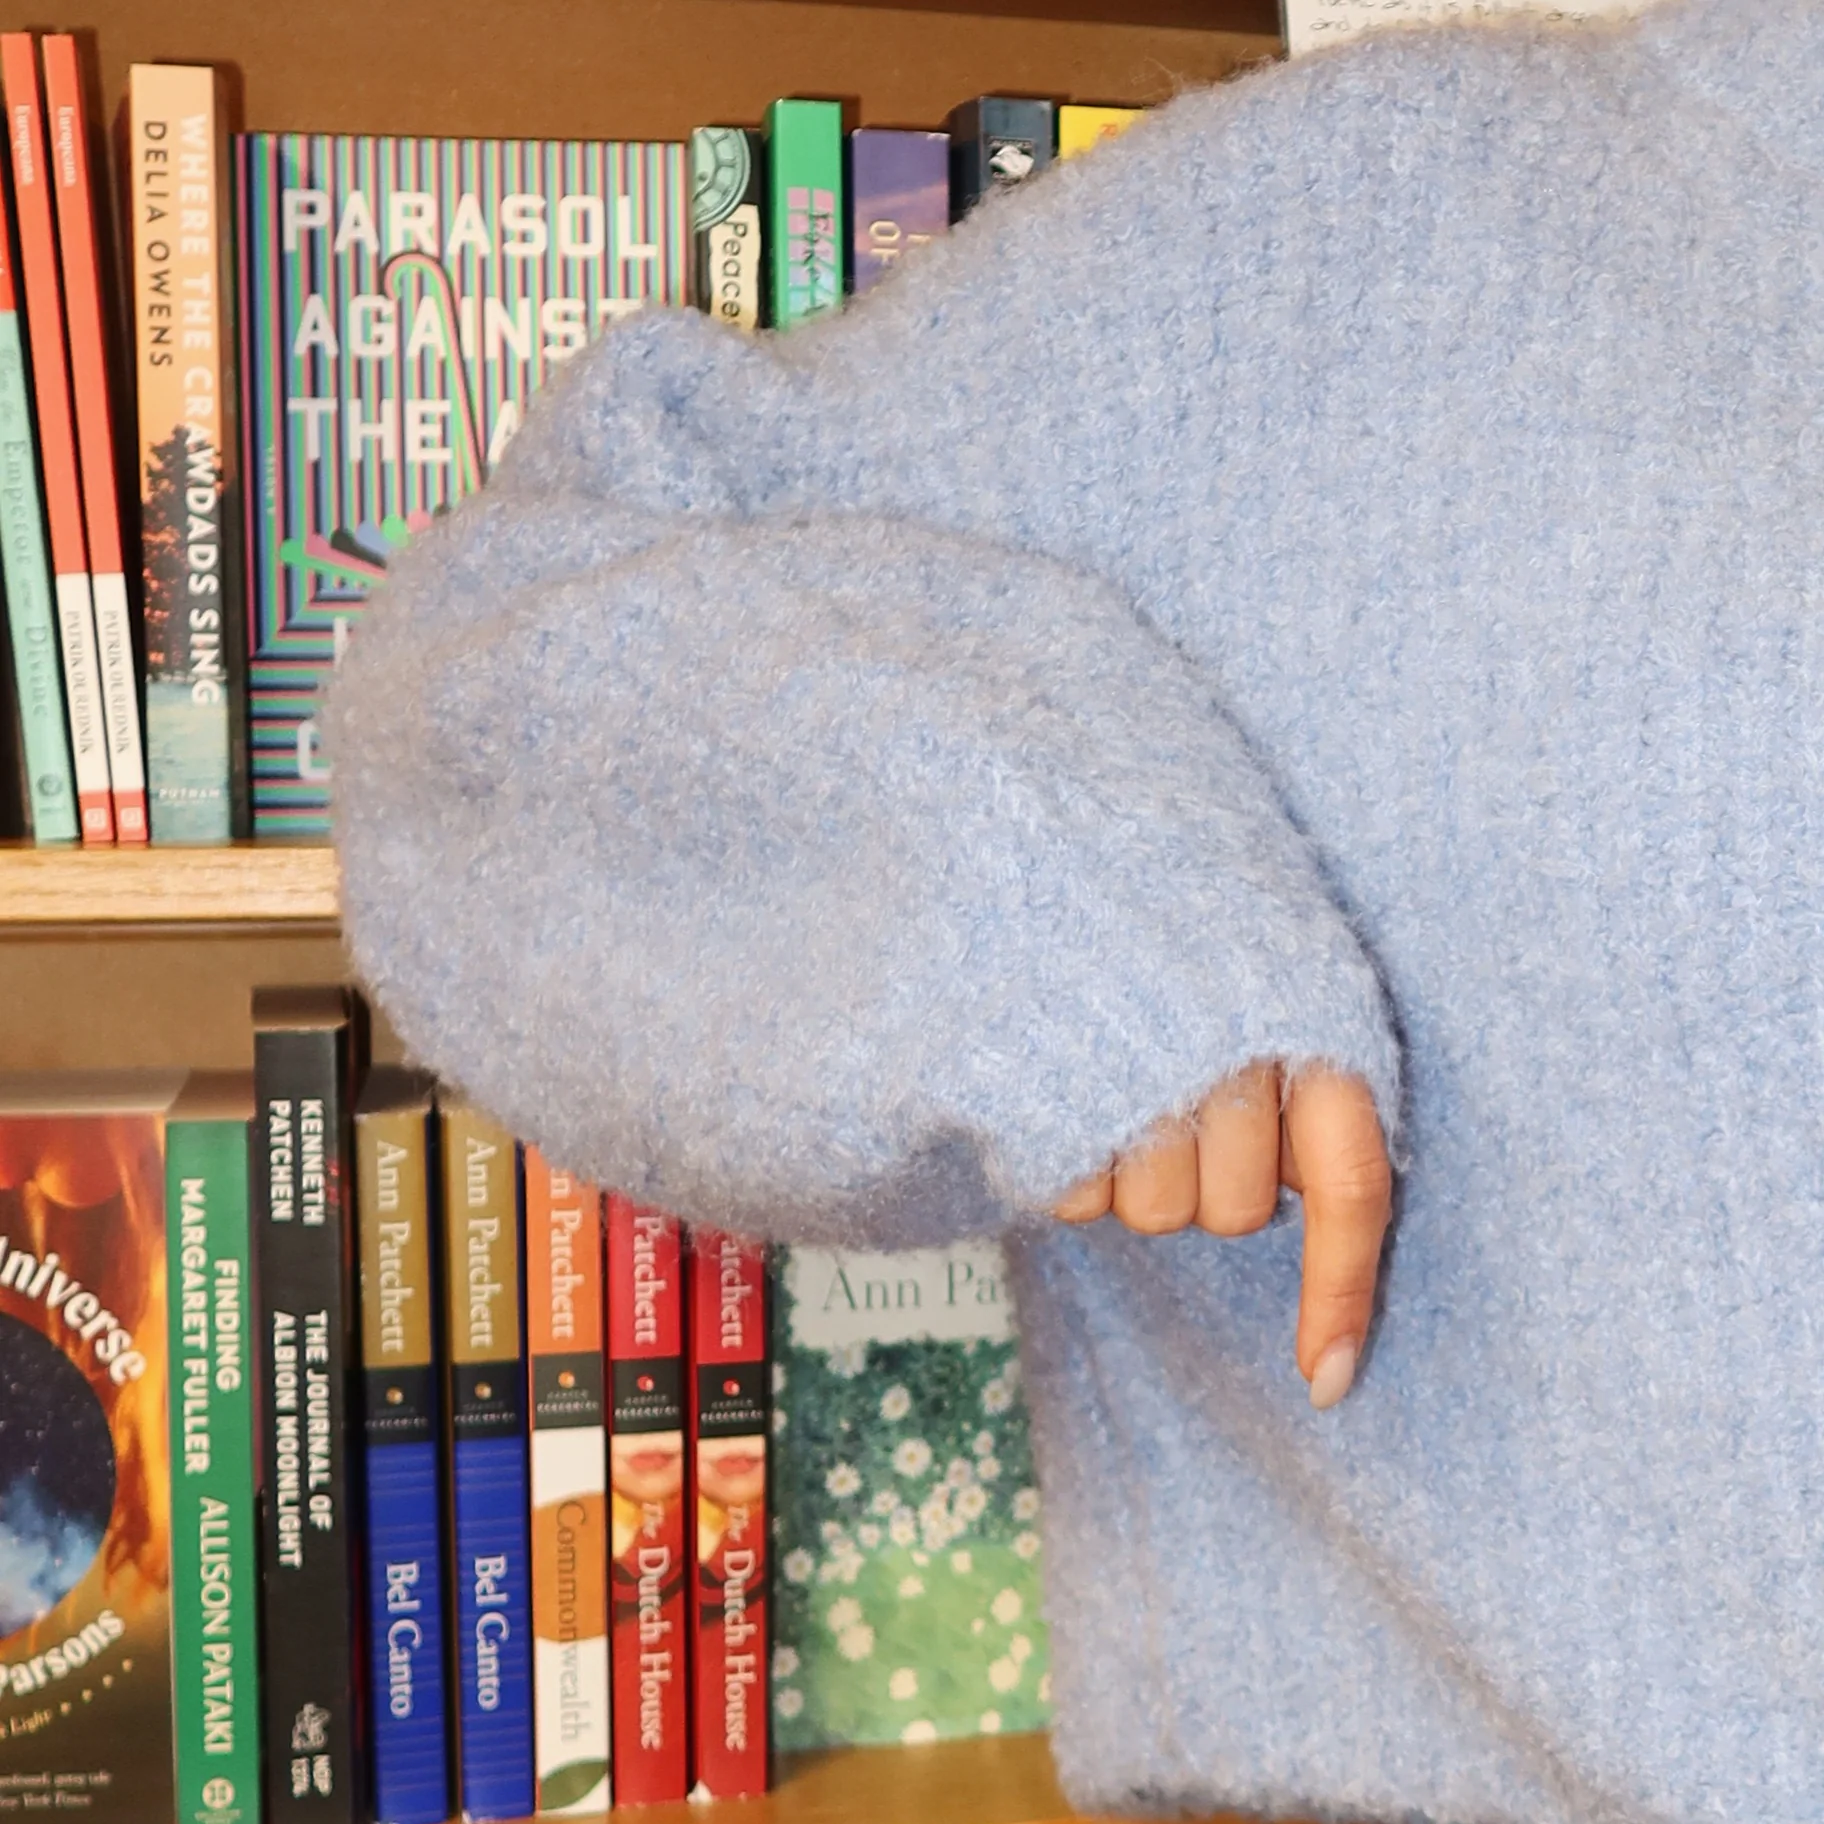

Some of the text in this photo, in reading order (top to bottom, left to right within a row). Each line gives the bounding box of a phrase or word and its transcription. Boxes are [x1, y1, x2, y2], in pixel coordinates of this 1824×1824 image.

[144, 122, 172, 367] DELIA OWENS
[282, 189, 658, 262] PARASOL
[180, 114, 220, 707] WHERE THE CRAWDADS SING
[285, 397, 453, 464] THE
[270, 1100, 290, 1223] PATCHEN
[302, 1100, 325, 1228] KENNETH
[214, 1259, 241, 1392] FINDING
[375, 1141, 410, 1353] Ann Patchett
[824, 1267, 923, 1311] Ann
[180, 1179, 210, 1475] MARGARET FULLER
[274, 1310, 300, 1569] ALBION MOONLIGHT
[304, 1310, 333, 1531] THE JOURNAL OF
[550, 1205, 590, 1744] Patchett Commonwealth
[199, 1496, 234, 1755] ALLISON PATAKI
[385, 1562, 423, 1719] Bel Canto
[640, 1545, 671, 1643] Dutch
[640, 1652, 672, 1752] House
